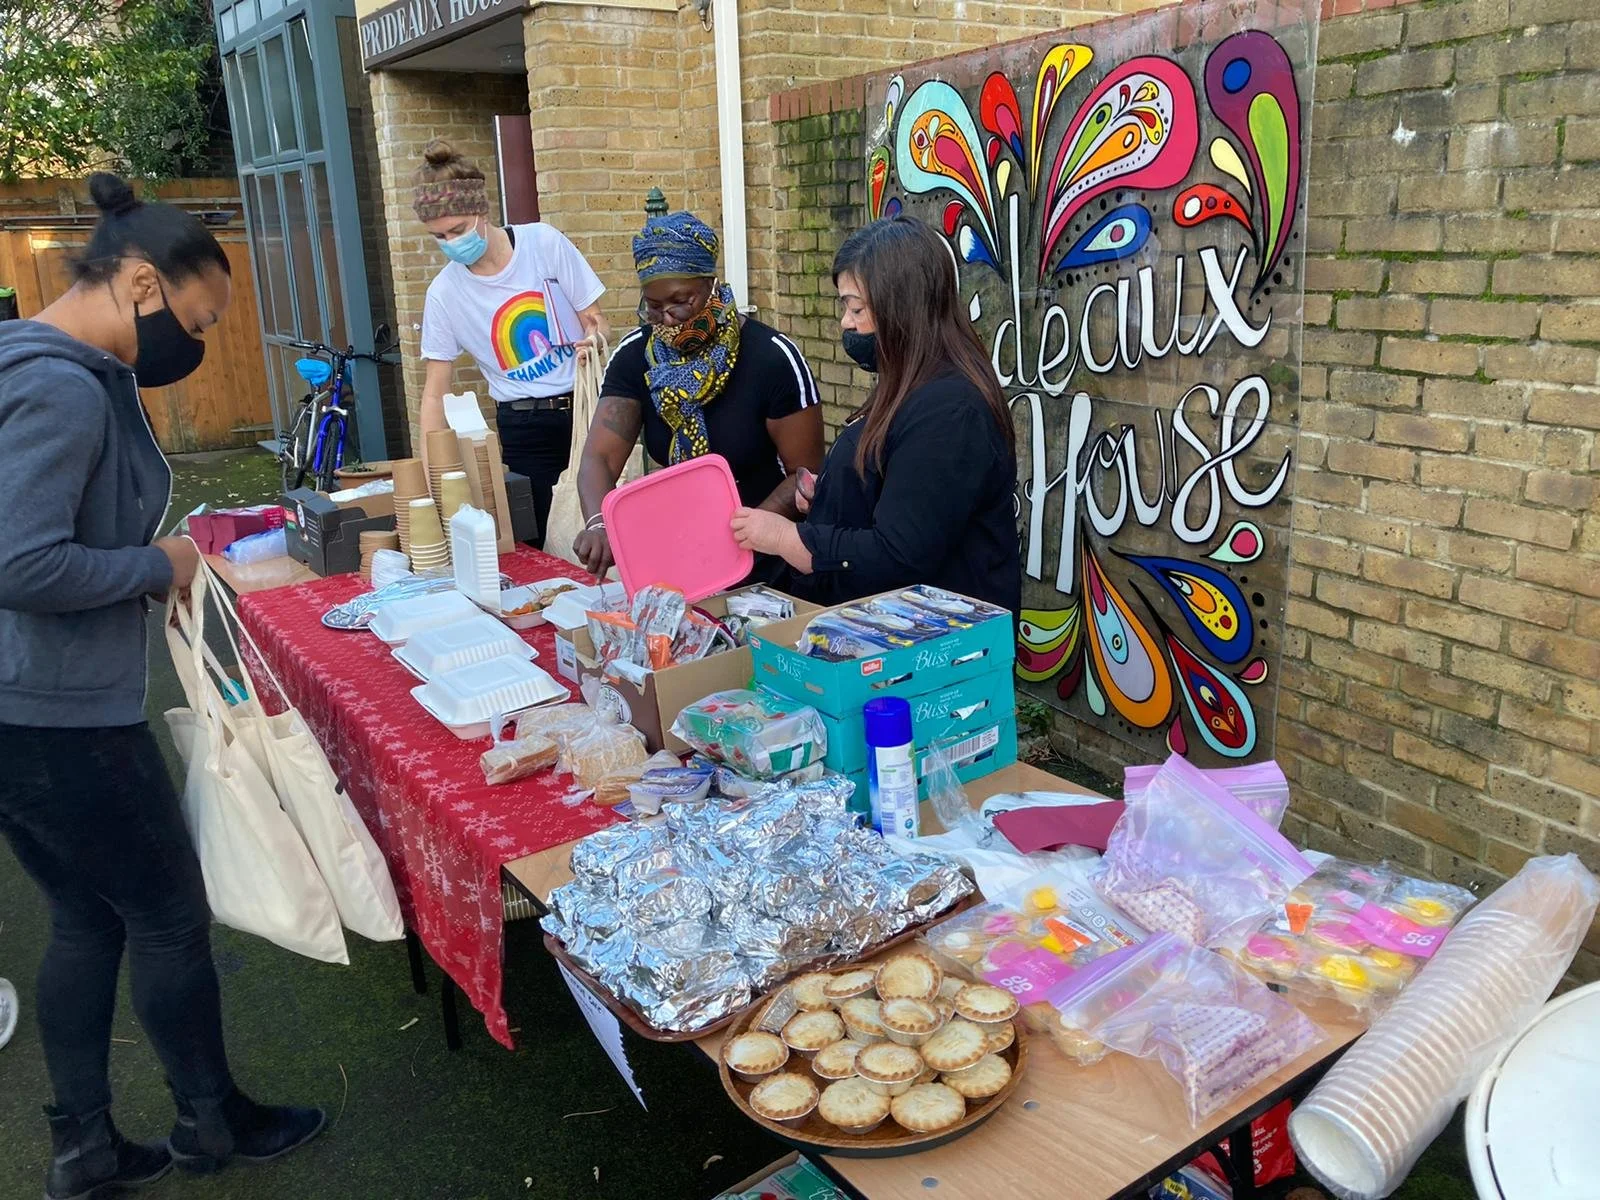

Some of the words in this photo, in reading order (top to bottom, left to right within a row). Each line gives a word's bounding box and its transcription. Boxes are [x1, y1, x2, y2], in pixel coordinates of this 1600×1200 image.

[361, 0, 444, 60] PRIDEAUX
[969, 193, 1272, 397] deaux
[507, 354, 558, 382] THANK
[555, 345, 577, 364] YO
[1008, 375, 1292, 596] House
[775, 653, 802, 680] Bliss
[915, 649, 949, 671] Bliss
[915, 701, 949, 723] Bliss
